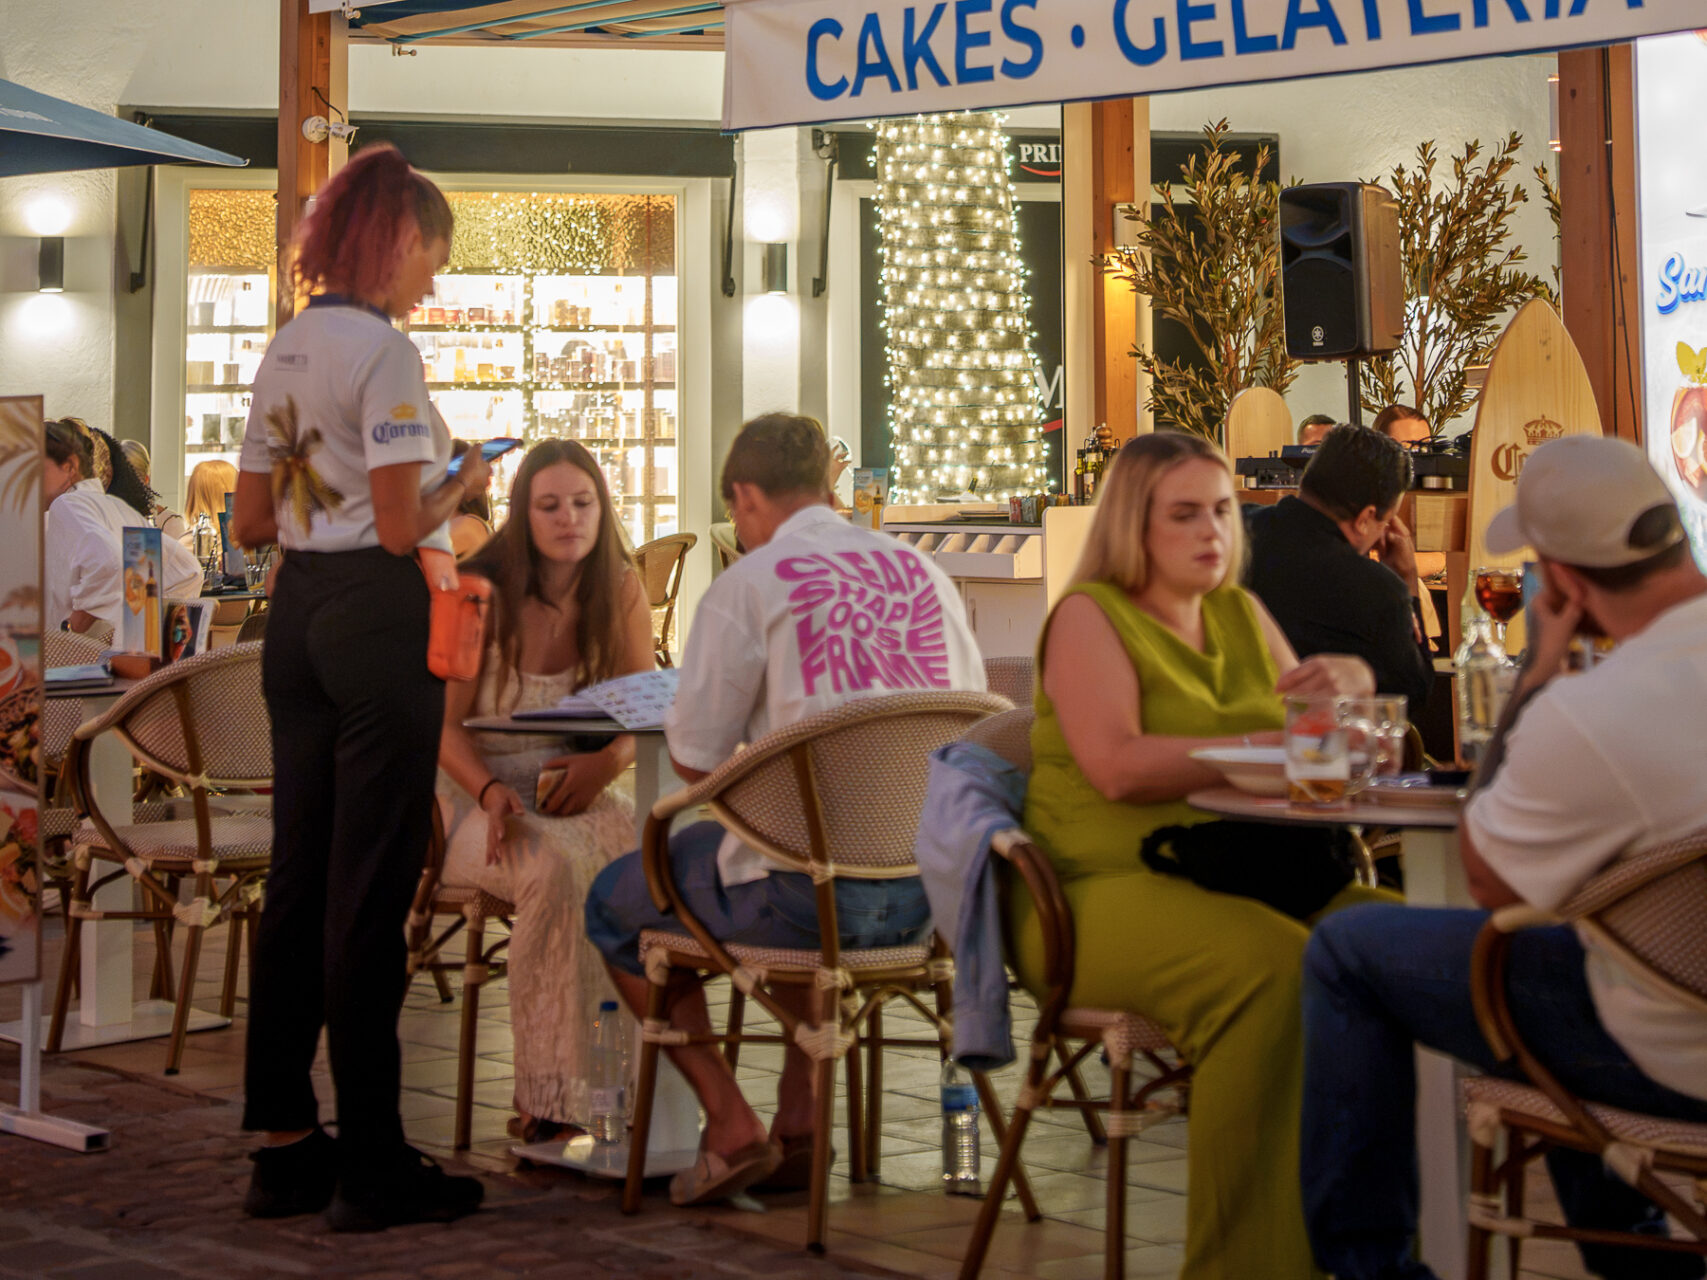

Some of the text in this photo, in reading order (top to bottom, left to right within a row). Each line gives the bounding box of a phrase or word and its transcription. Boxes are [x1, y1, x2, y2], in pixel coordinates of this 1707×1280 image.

[1019, 143, 1062, 163] PRI
[775, 550, 929, 596] CLEAR
[788, 579, 942, 627] SHAPE
[796, 600, 947, 658] LOOSE
[801, 634, 951, 697] FRAME
